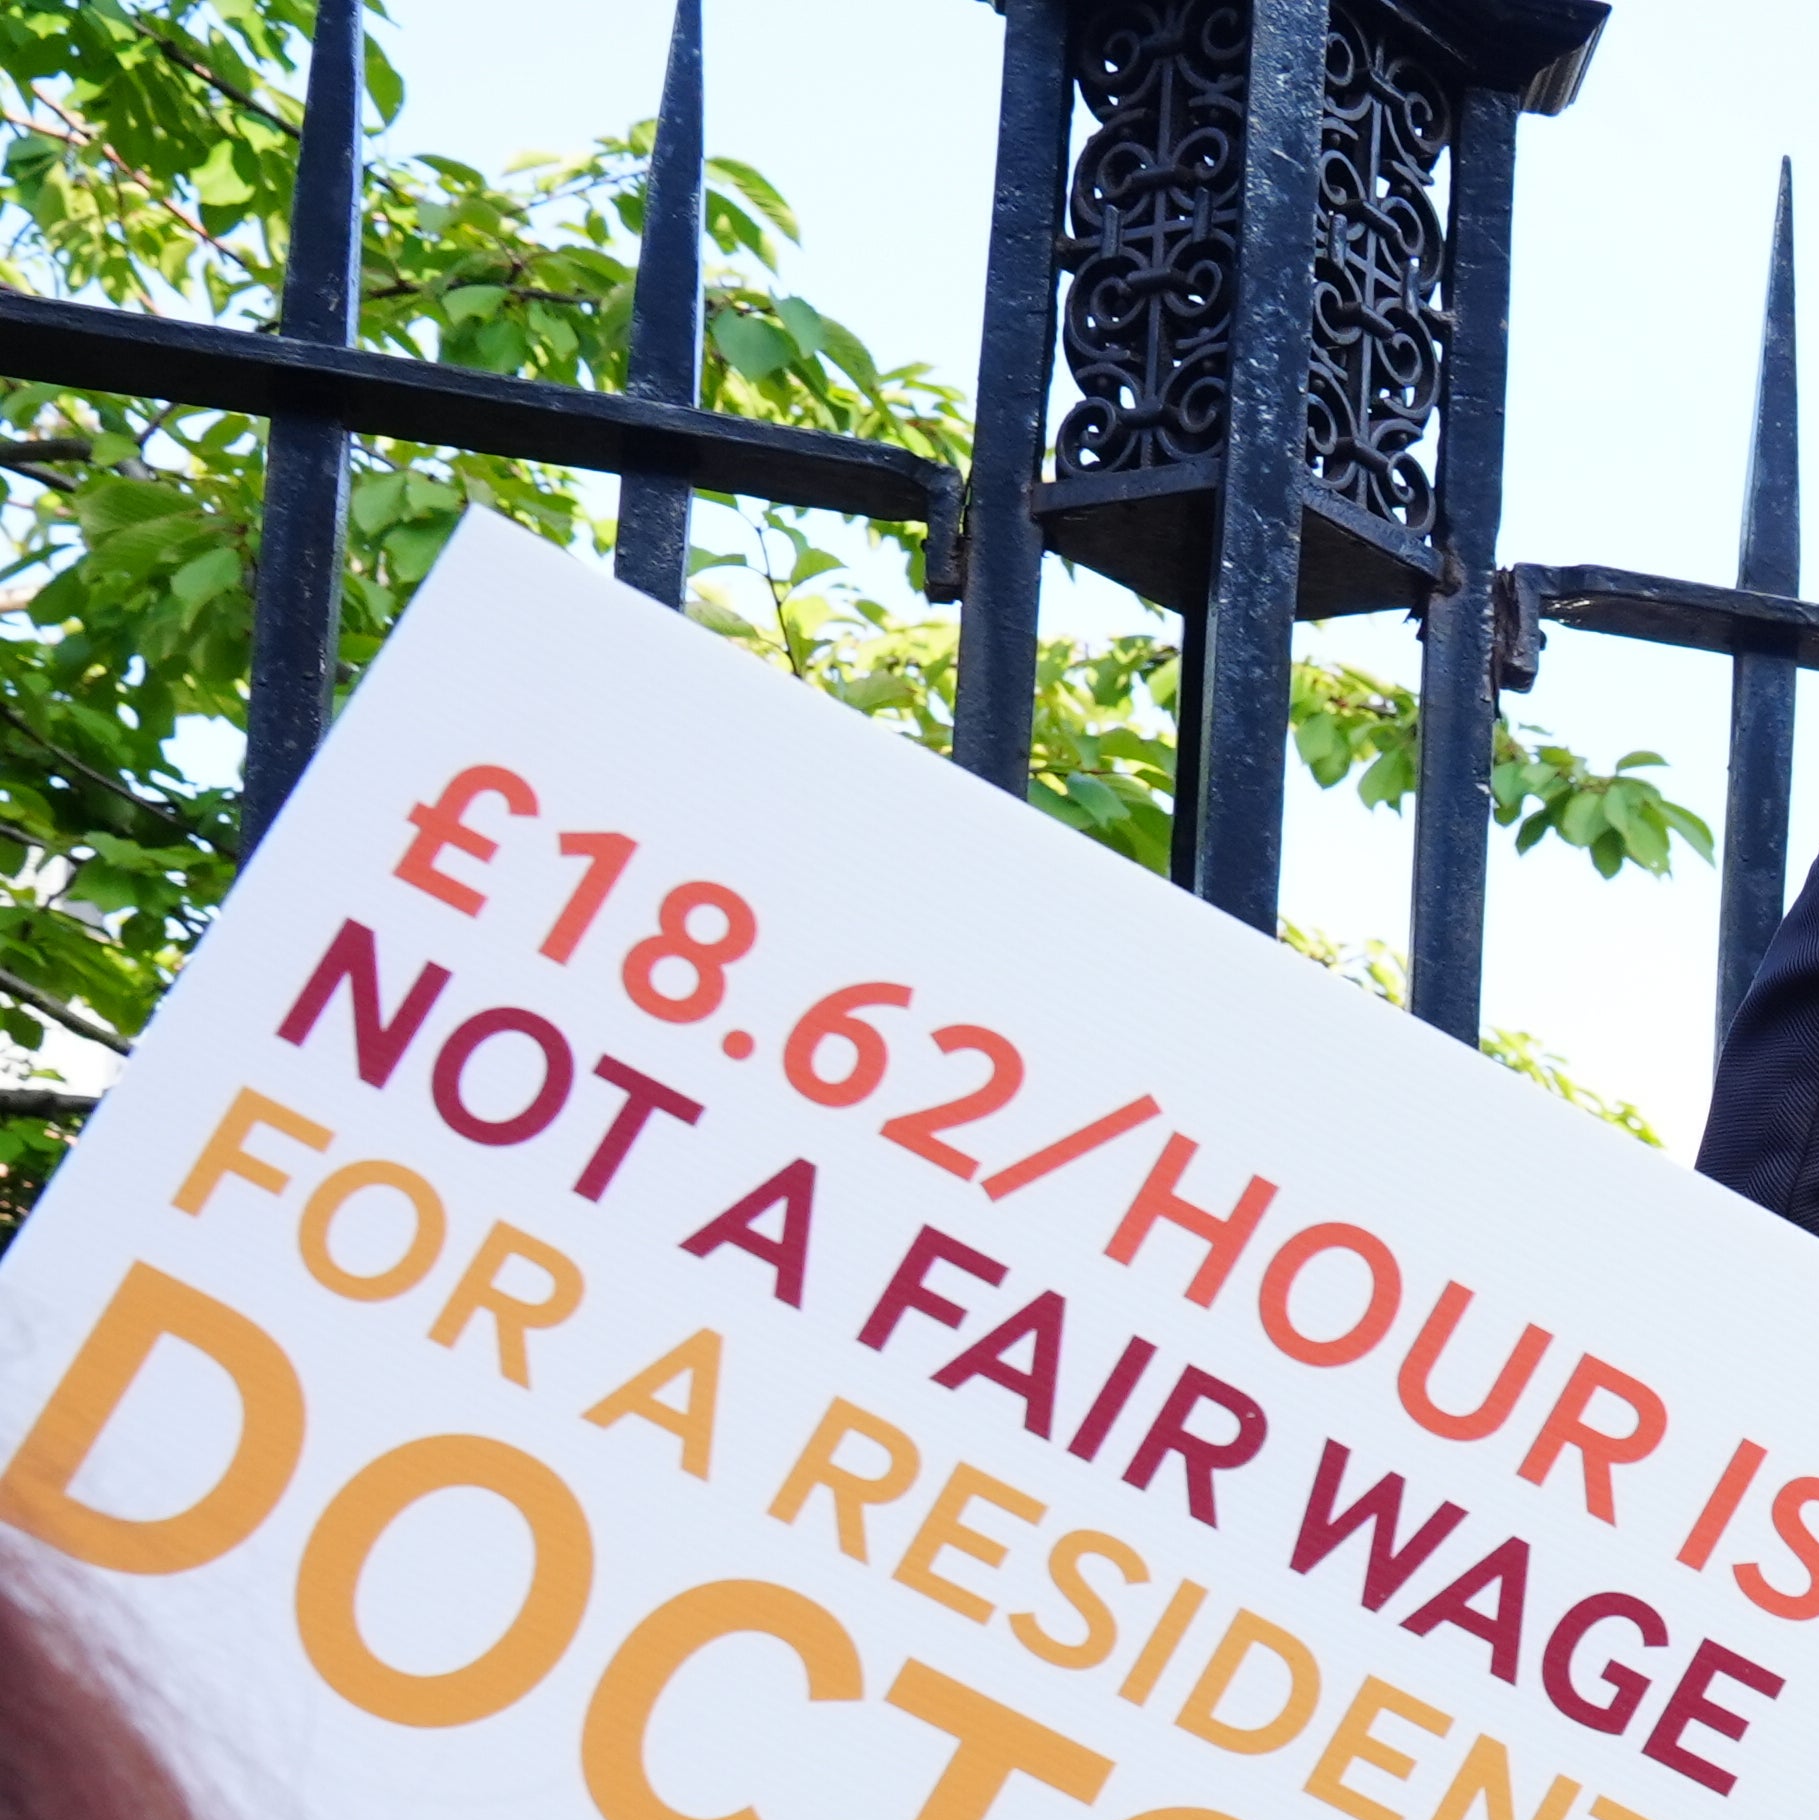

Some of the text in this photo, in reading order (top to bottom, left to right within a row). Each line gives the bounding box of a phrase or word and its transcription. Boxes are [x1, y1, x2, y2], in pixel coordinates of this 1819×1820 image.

[170, 1085, 587, 1391] FOR
[580, 1329, 724, 1480] A
[275, 916, 1785, 1795] NOT A FAIR WAGE
[388, 761, 1668, 1528] £18.62/HOUR
